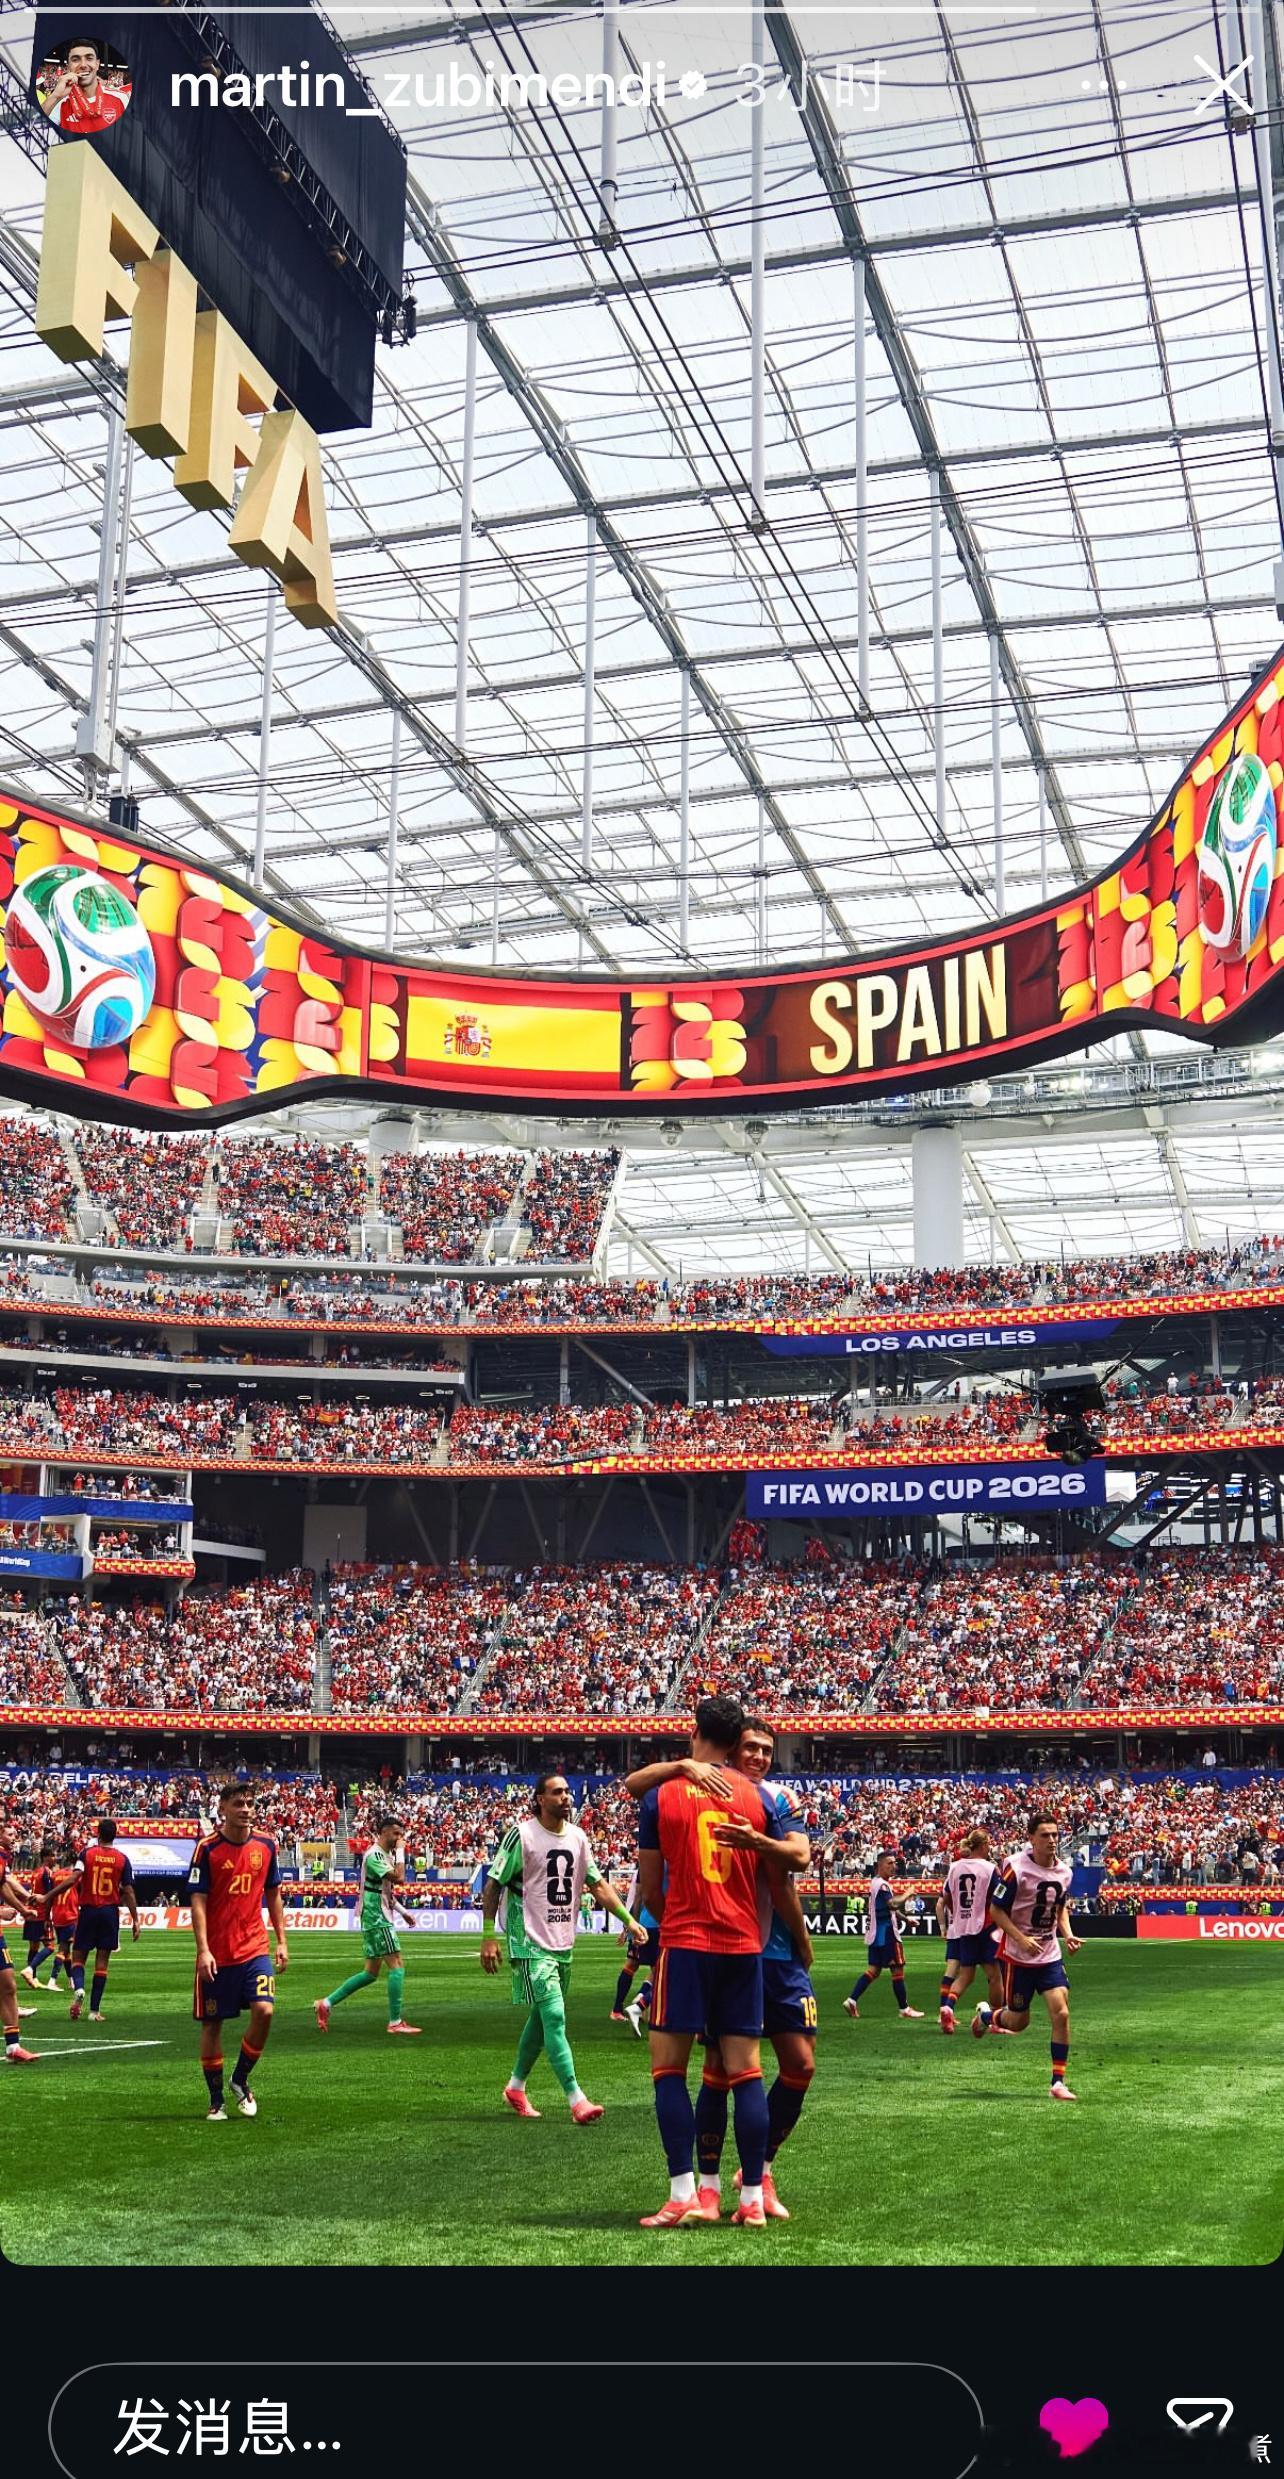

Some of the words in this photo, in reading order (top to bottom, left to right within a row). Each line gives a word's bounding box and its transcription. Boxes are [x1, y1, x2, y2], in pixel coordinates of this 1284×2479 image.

[36, 139, 338, 630] FIFA
[810, 943, 1007, 1074] SPAIN
[846, 1336, 900, 1353] LOS
[906, 1330, 1036, 1349] ANGELES
[763, 1484, 820, 1504] FIFA
[825, 1482, 923, 1504] WORLD
[929, 1479, 983, 1500] CUP
[988, 1473, 1086, 1498] 2026
[697, 1811, 732, 1883] 6
[92, 1866, 113, 1896] 16
[229, 1873, 251, 1894] 20
[256, 1974, 275, 1997] 20
